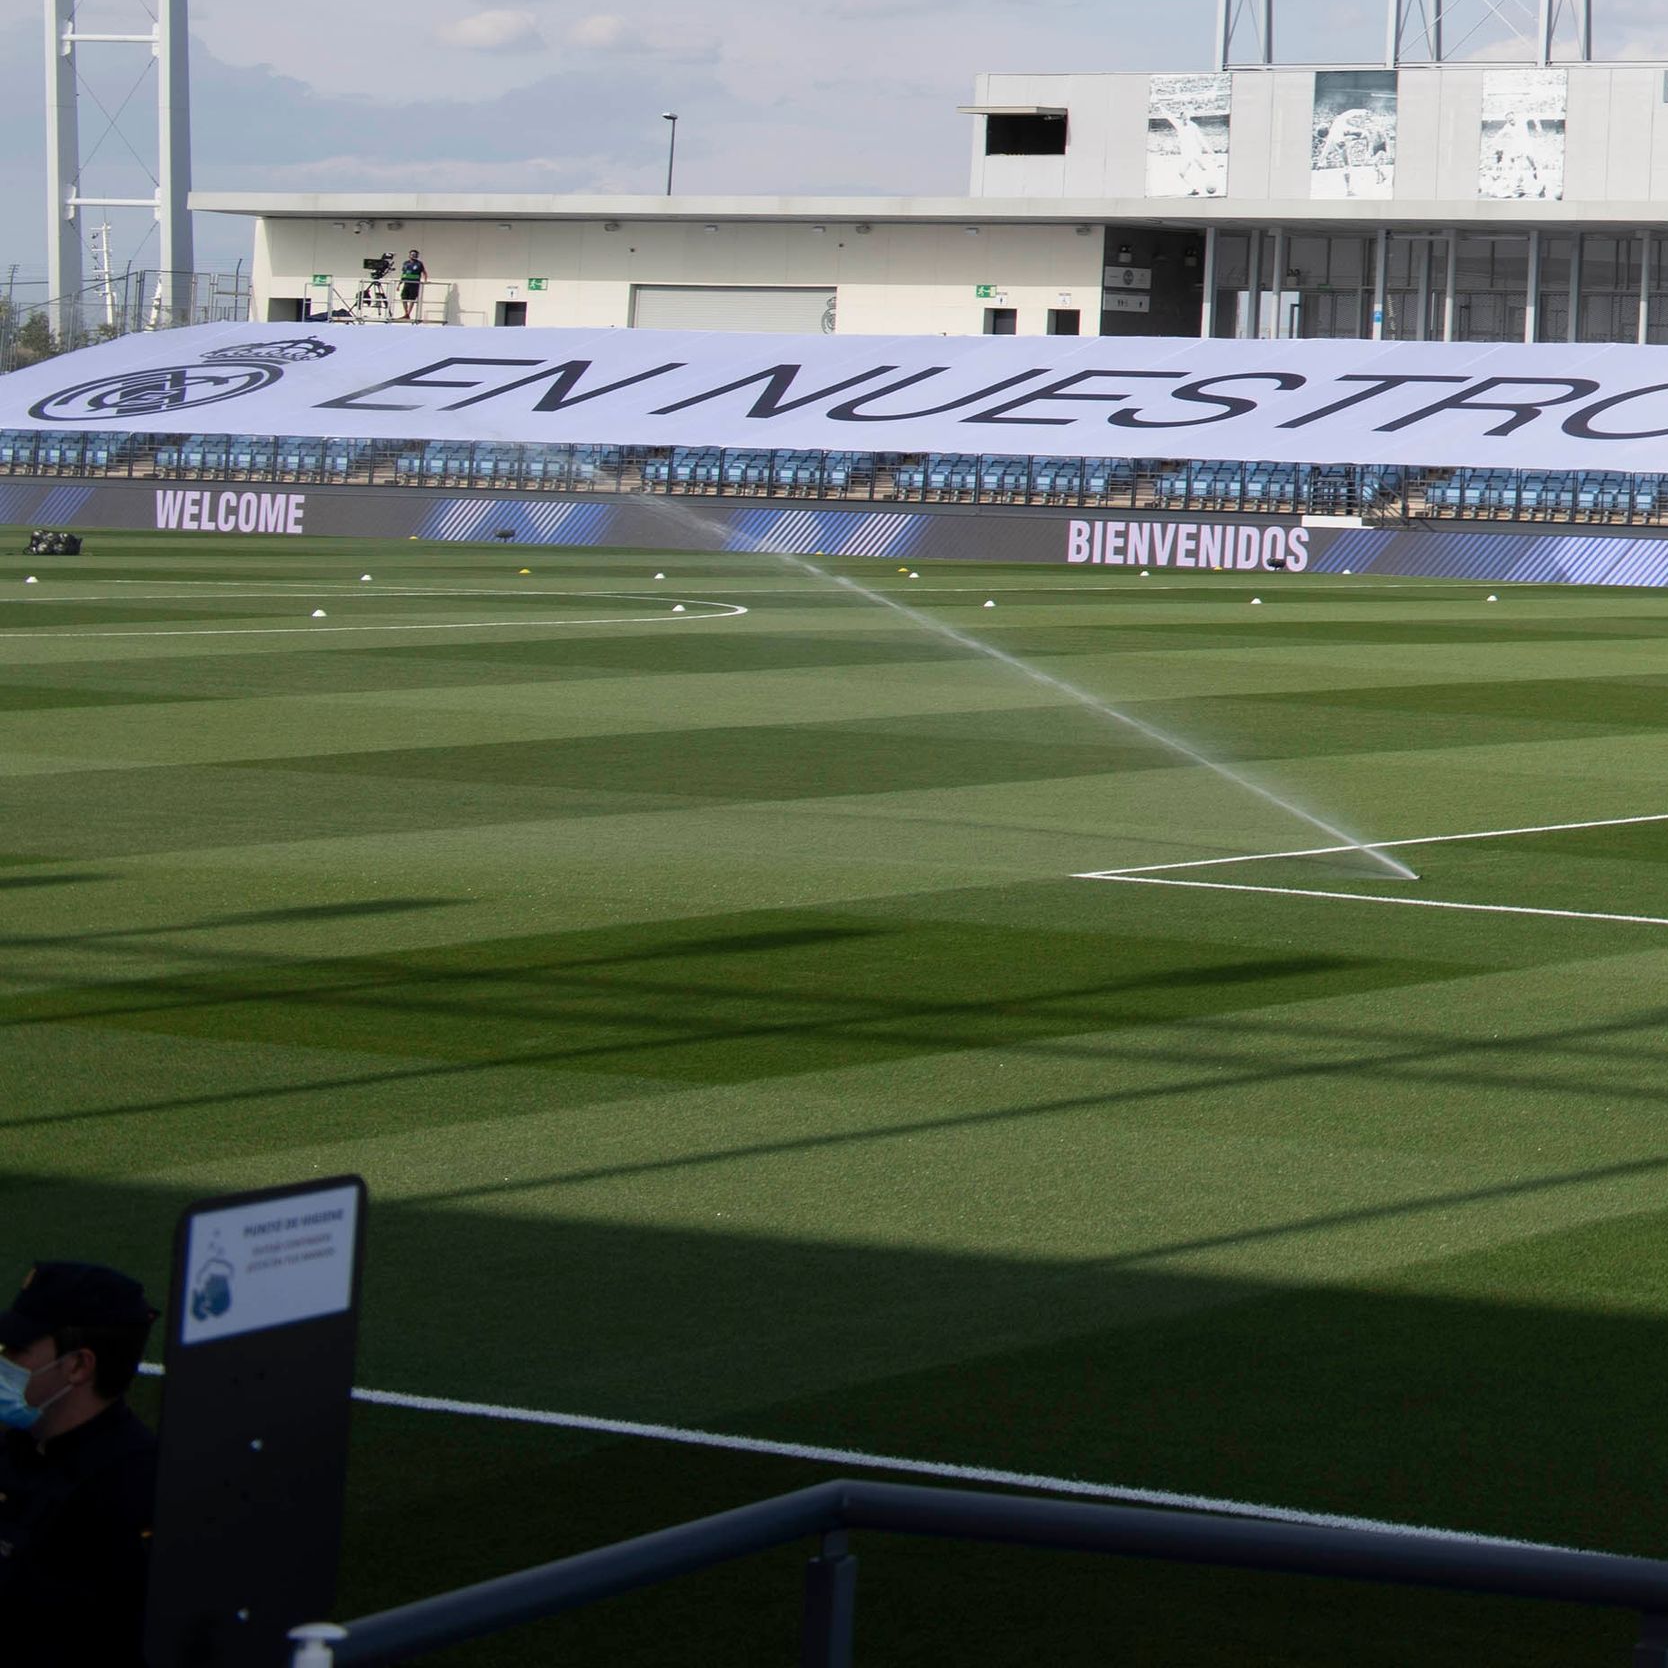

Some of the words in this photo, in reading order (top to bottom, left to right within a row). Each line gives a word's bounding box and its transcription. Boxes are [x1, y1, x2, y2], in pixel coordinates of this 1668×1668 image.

[311, 357, 688, 412] EN
[155, 489, 305, 534] WELCOME
[1067, 520, 1310, 572] BIENVENIDOS
